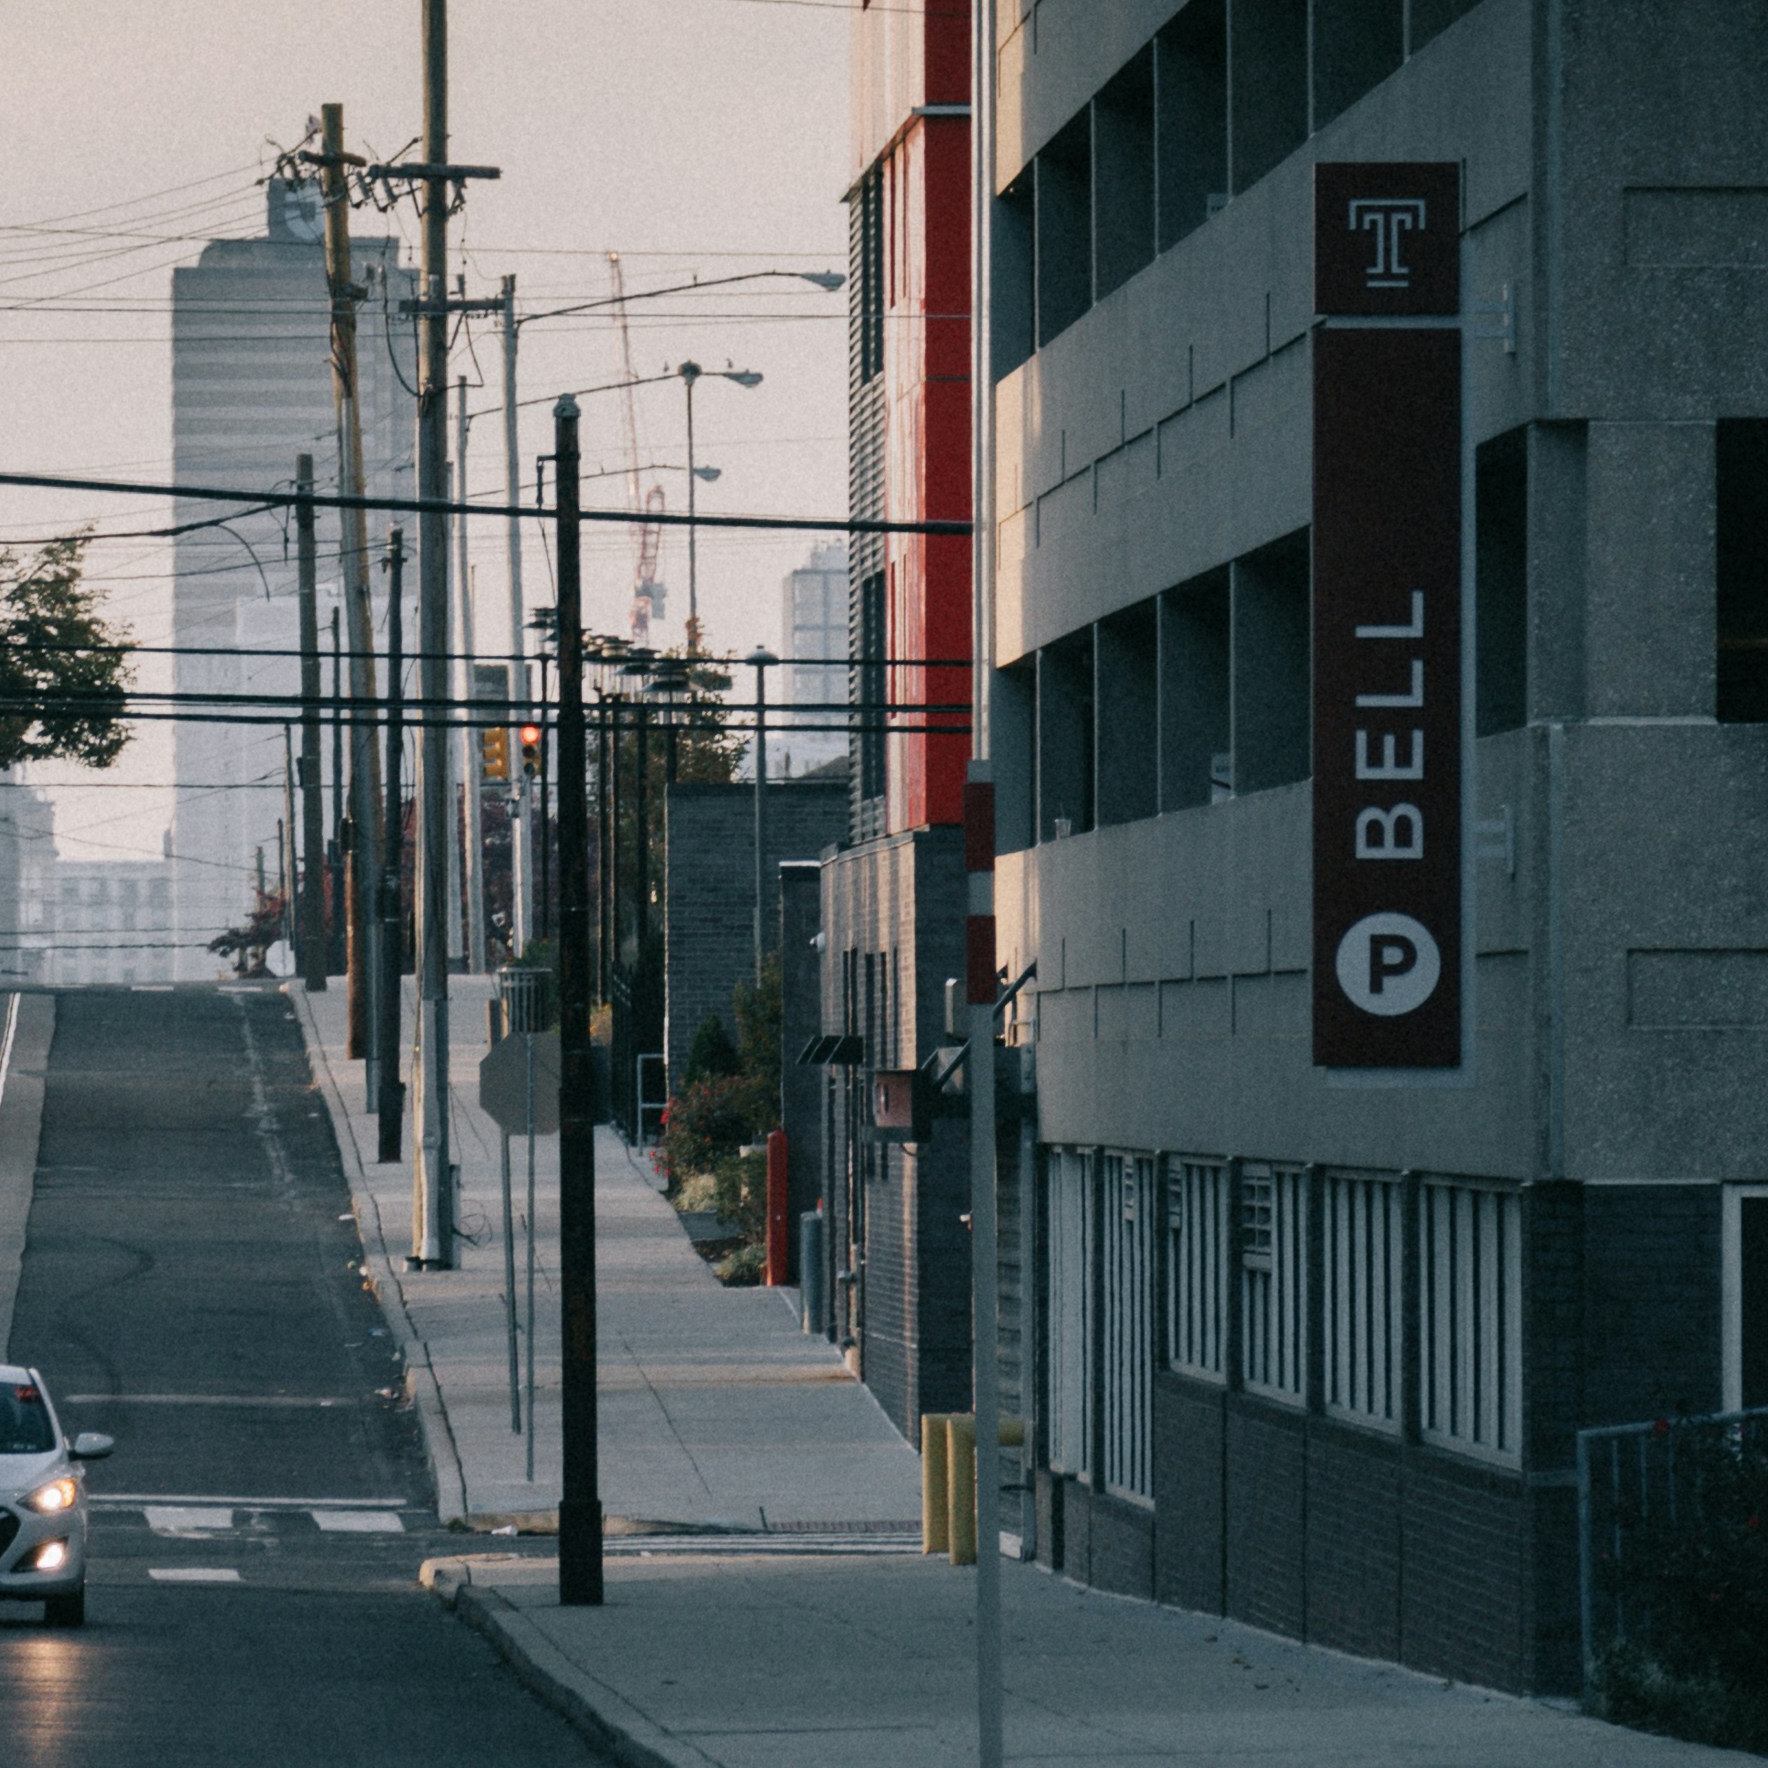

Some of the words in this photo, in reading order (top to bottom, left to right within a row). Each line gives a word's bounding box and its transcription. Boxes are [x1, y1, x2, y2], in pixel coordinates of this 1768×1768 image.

[1348, 198, 1426, 288] T
[1355, 590, 1424, 860] BELL
[1368, 933, 1418, 995] P
